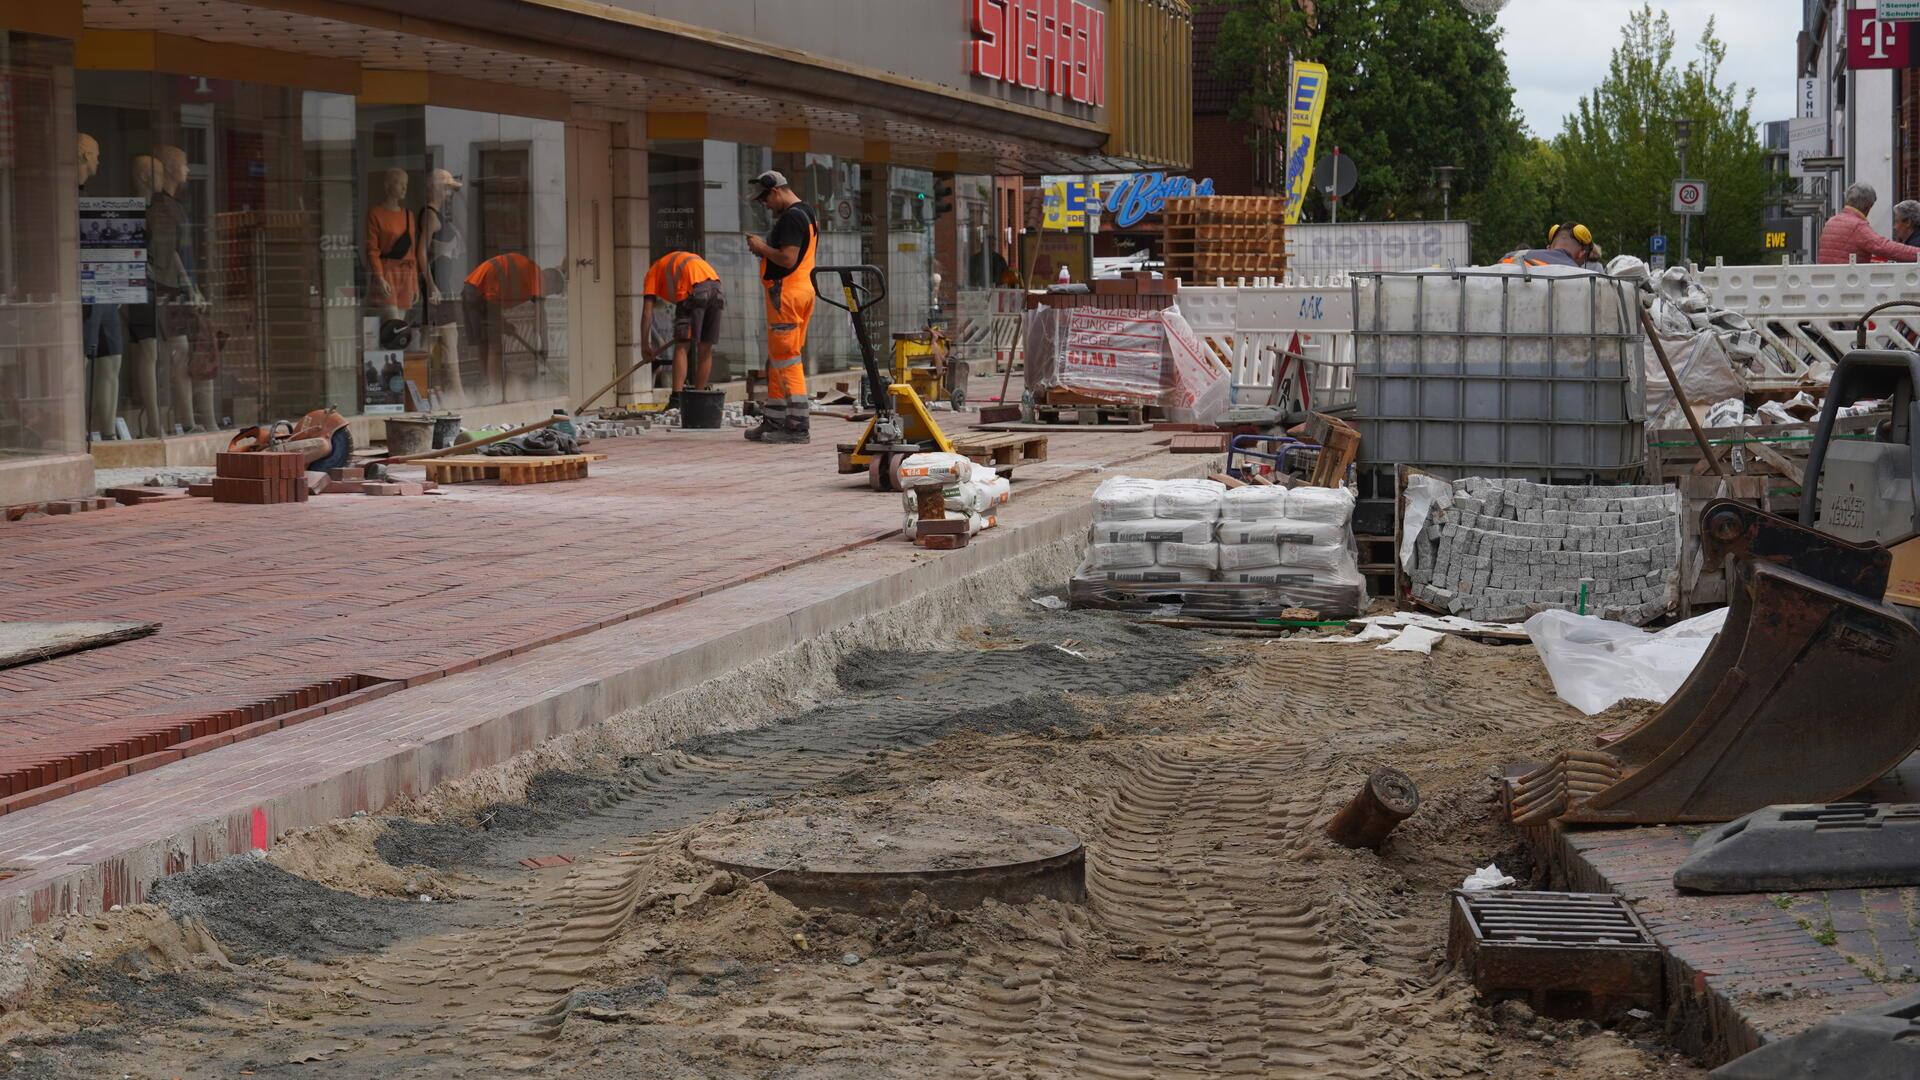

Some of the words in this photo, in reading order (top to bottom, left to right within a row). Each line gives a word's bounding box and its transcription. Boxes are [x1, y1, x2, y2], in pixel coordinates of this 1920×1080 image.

[971, 0, 1104, 107] STEFFEN
[1684, 189, 1696, 200] 20
[1653, 238, 1663, 251] P
[1765, 231, 1786, 249] EWE
[1071, 318, 1126, 333] KLINKER
[1069, 333, 1113, 347] ZIEGEL
[1829, 496, 1866, 513] WACKER
[1827, 511, 1865, 528] NEUSON
